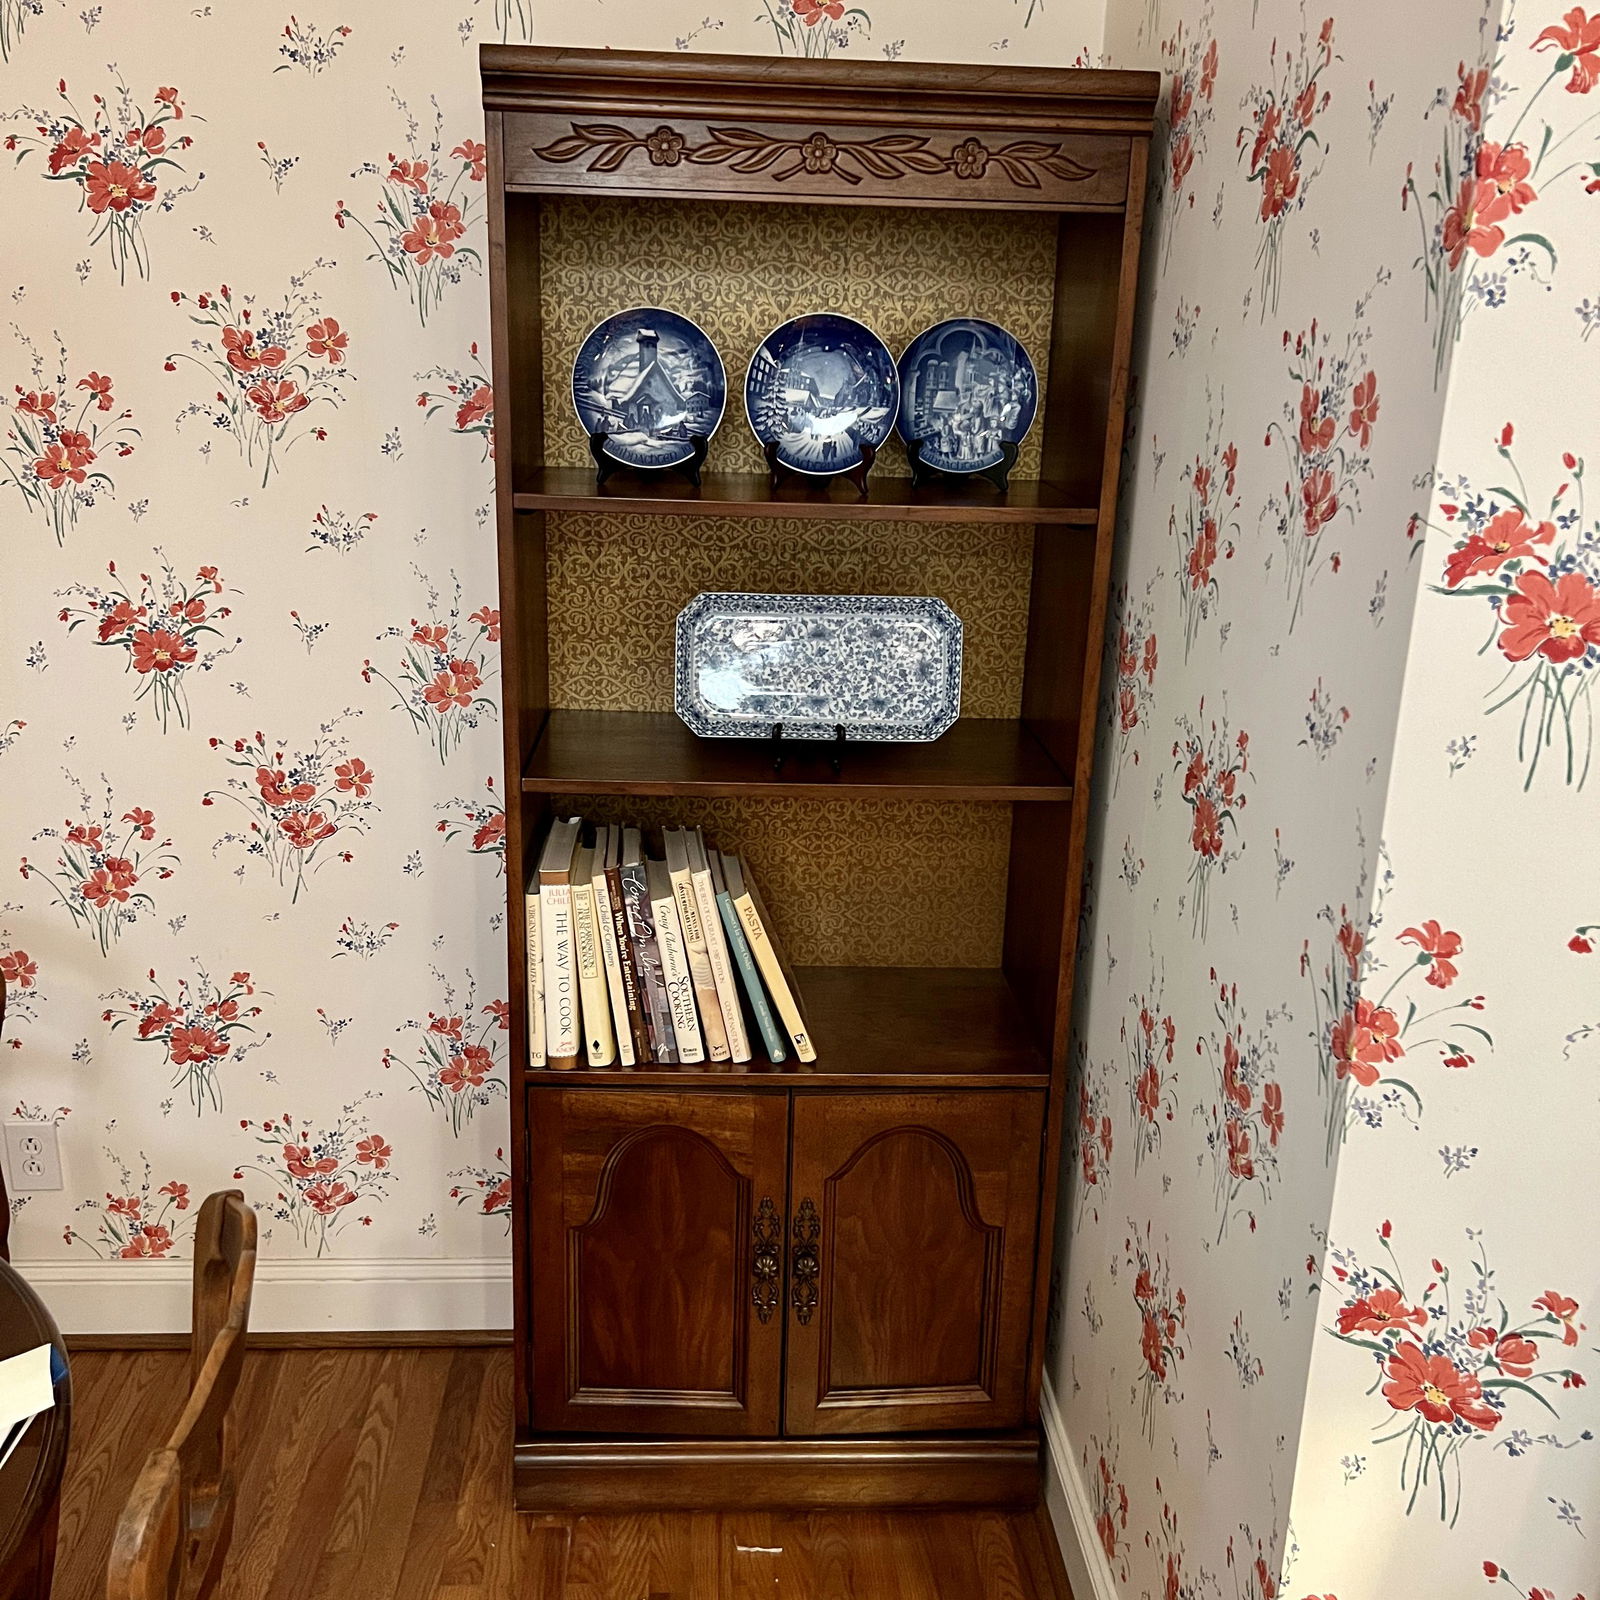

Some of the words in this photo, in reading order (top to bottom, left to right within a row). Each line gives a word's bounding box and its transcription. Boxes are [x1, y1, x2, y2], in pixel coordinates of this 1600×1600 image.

[596, 889, 605, 904] Julia
[621, 871, 646, 920] Come
[678, 883, 691, 923] CONTEMPORARY
[528, 904, 537, 940] VIRGINIA
[556, 910, 567, 936] THE
[600, 905, 609, 925] Child
[614, 912, 625, 935] When
[659, 905, 670, 930] Craig
[744, 906, 763, 940] PASTA
[579, 929, 589, 970] COOKBOOK
[603, 933, 615, 968] Company
[619, 935, 630, 959] You're
[631, 921, 652, 950] On
[529, 940, 537, 983] CELEBRATES
[557, 939, 570, 971] WAY
[664, 931, 681, 977] Claiborne's
[743, 952, 752, 970] Order
[558, 974, 570, 992] TO
[622, 961, 636, 1011] Entertaining
[559, 997, 572, 1036] COOK
[667, 982, 686, 1029] COOKING
[677, 975, 697, 1031] SOUTHERN
